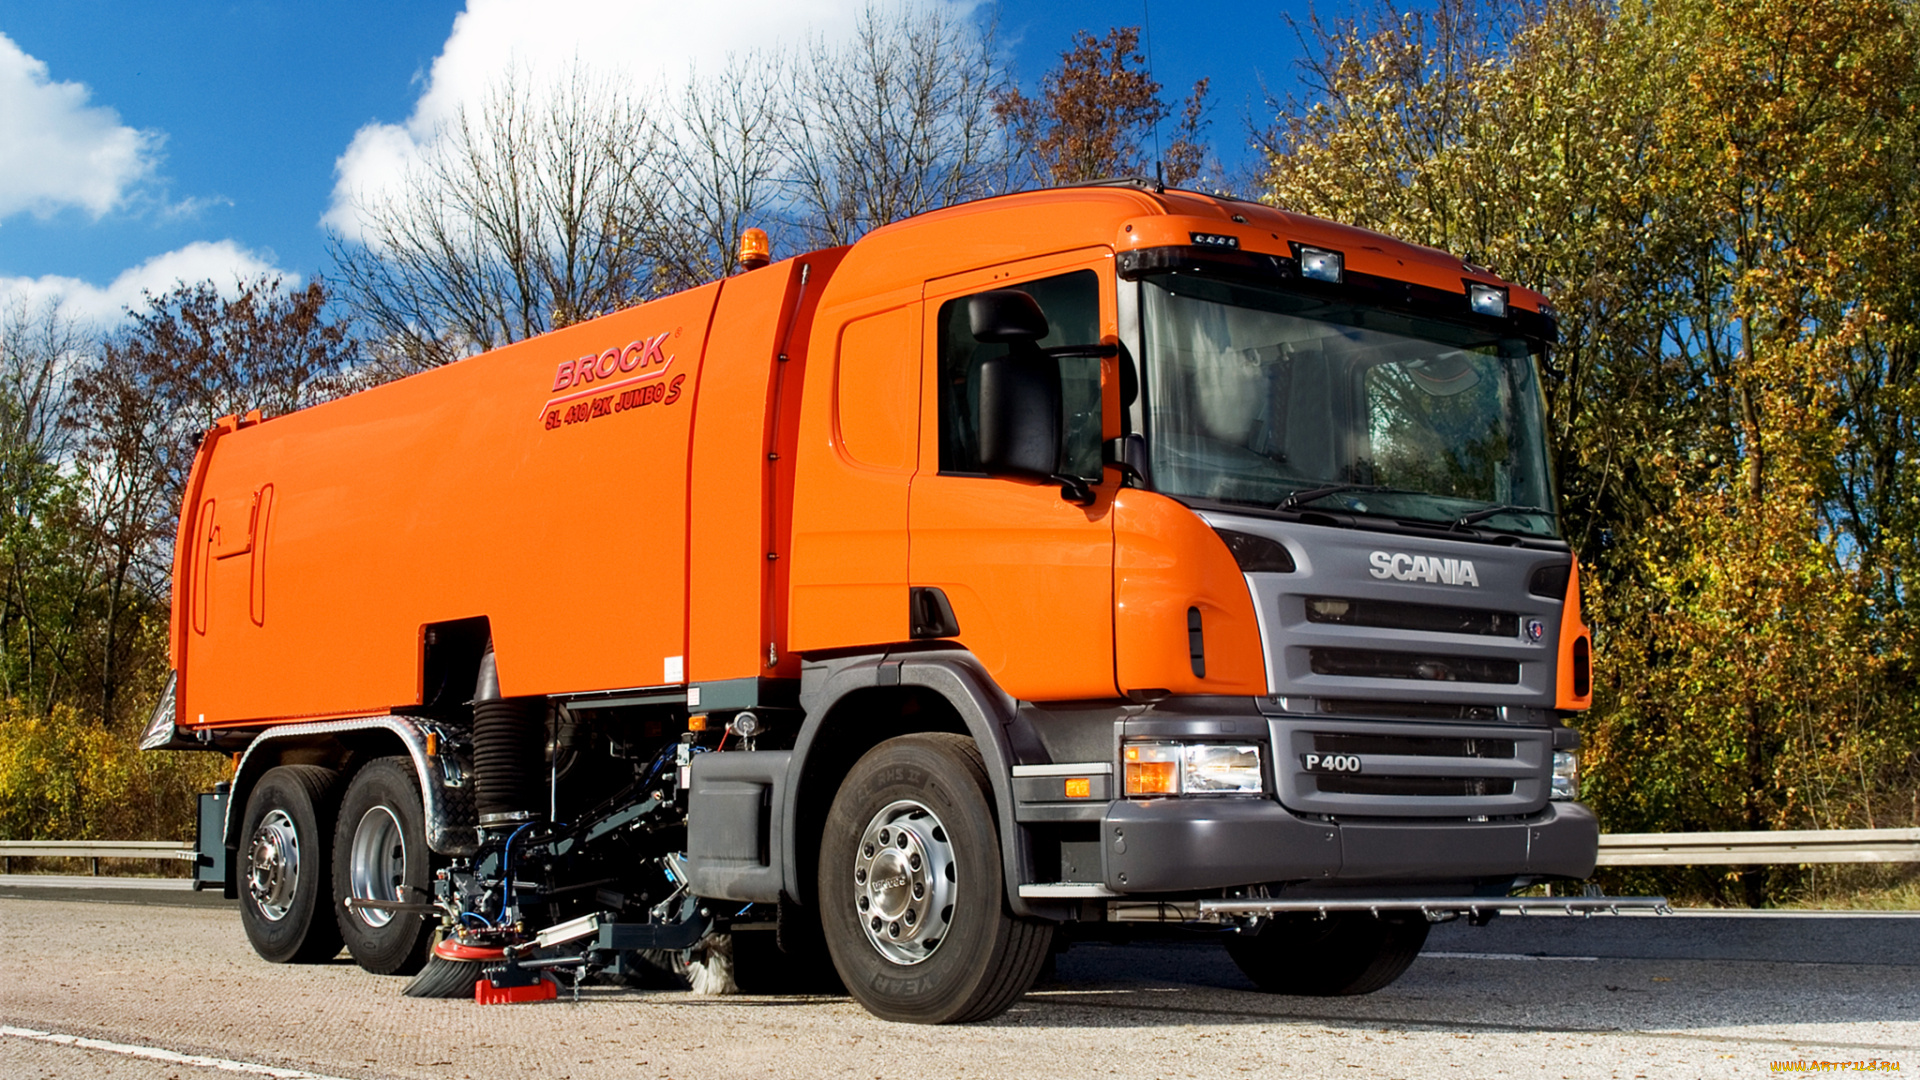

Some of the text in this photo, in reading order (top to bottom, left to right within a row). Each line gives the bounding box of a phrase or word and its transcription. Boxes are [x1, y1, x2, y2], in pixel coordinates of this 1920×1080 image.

[552, 331, 670, 392] BROCK
[545, 373, 686, 431] SL 410/2K JUMBO S
[1369, 550, 1480, 587] SCANIA
[1306, 754, 1361, 772] P 400
